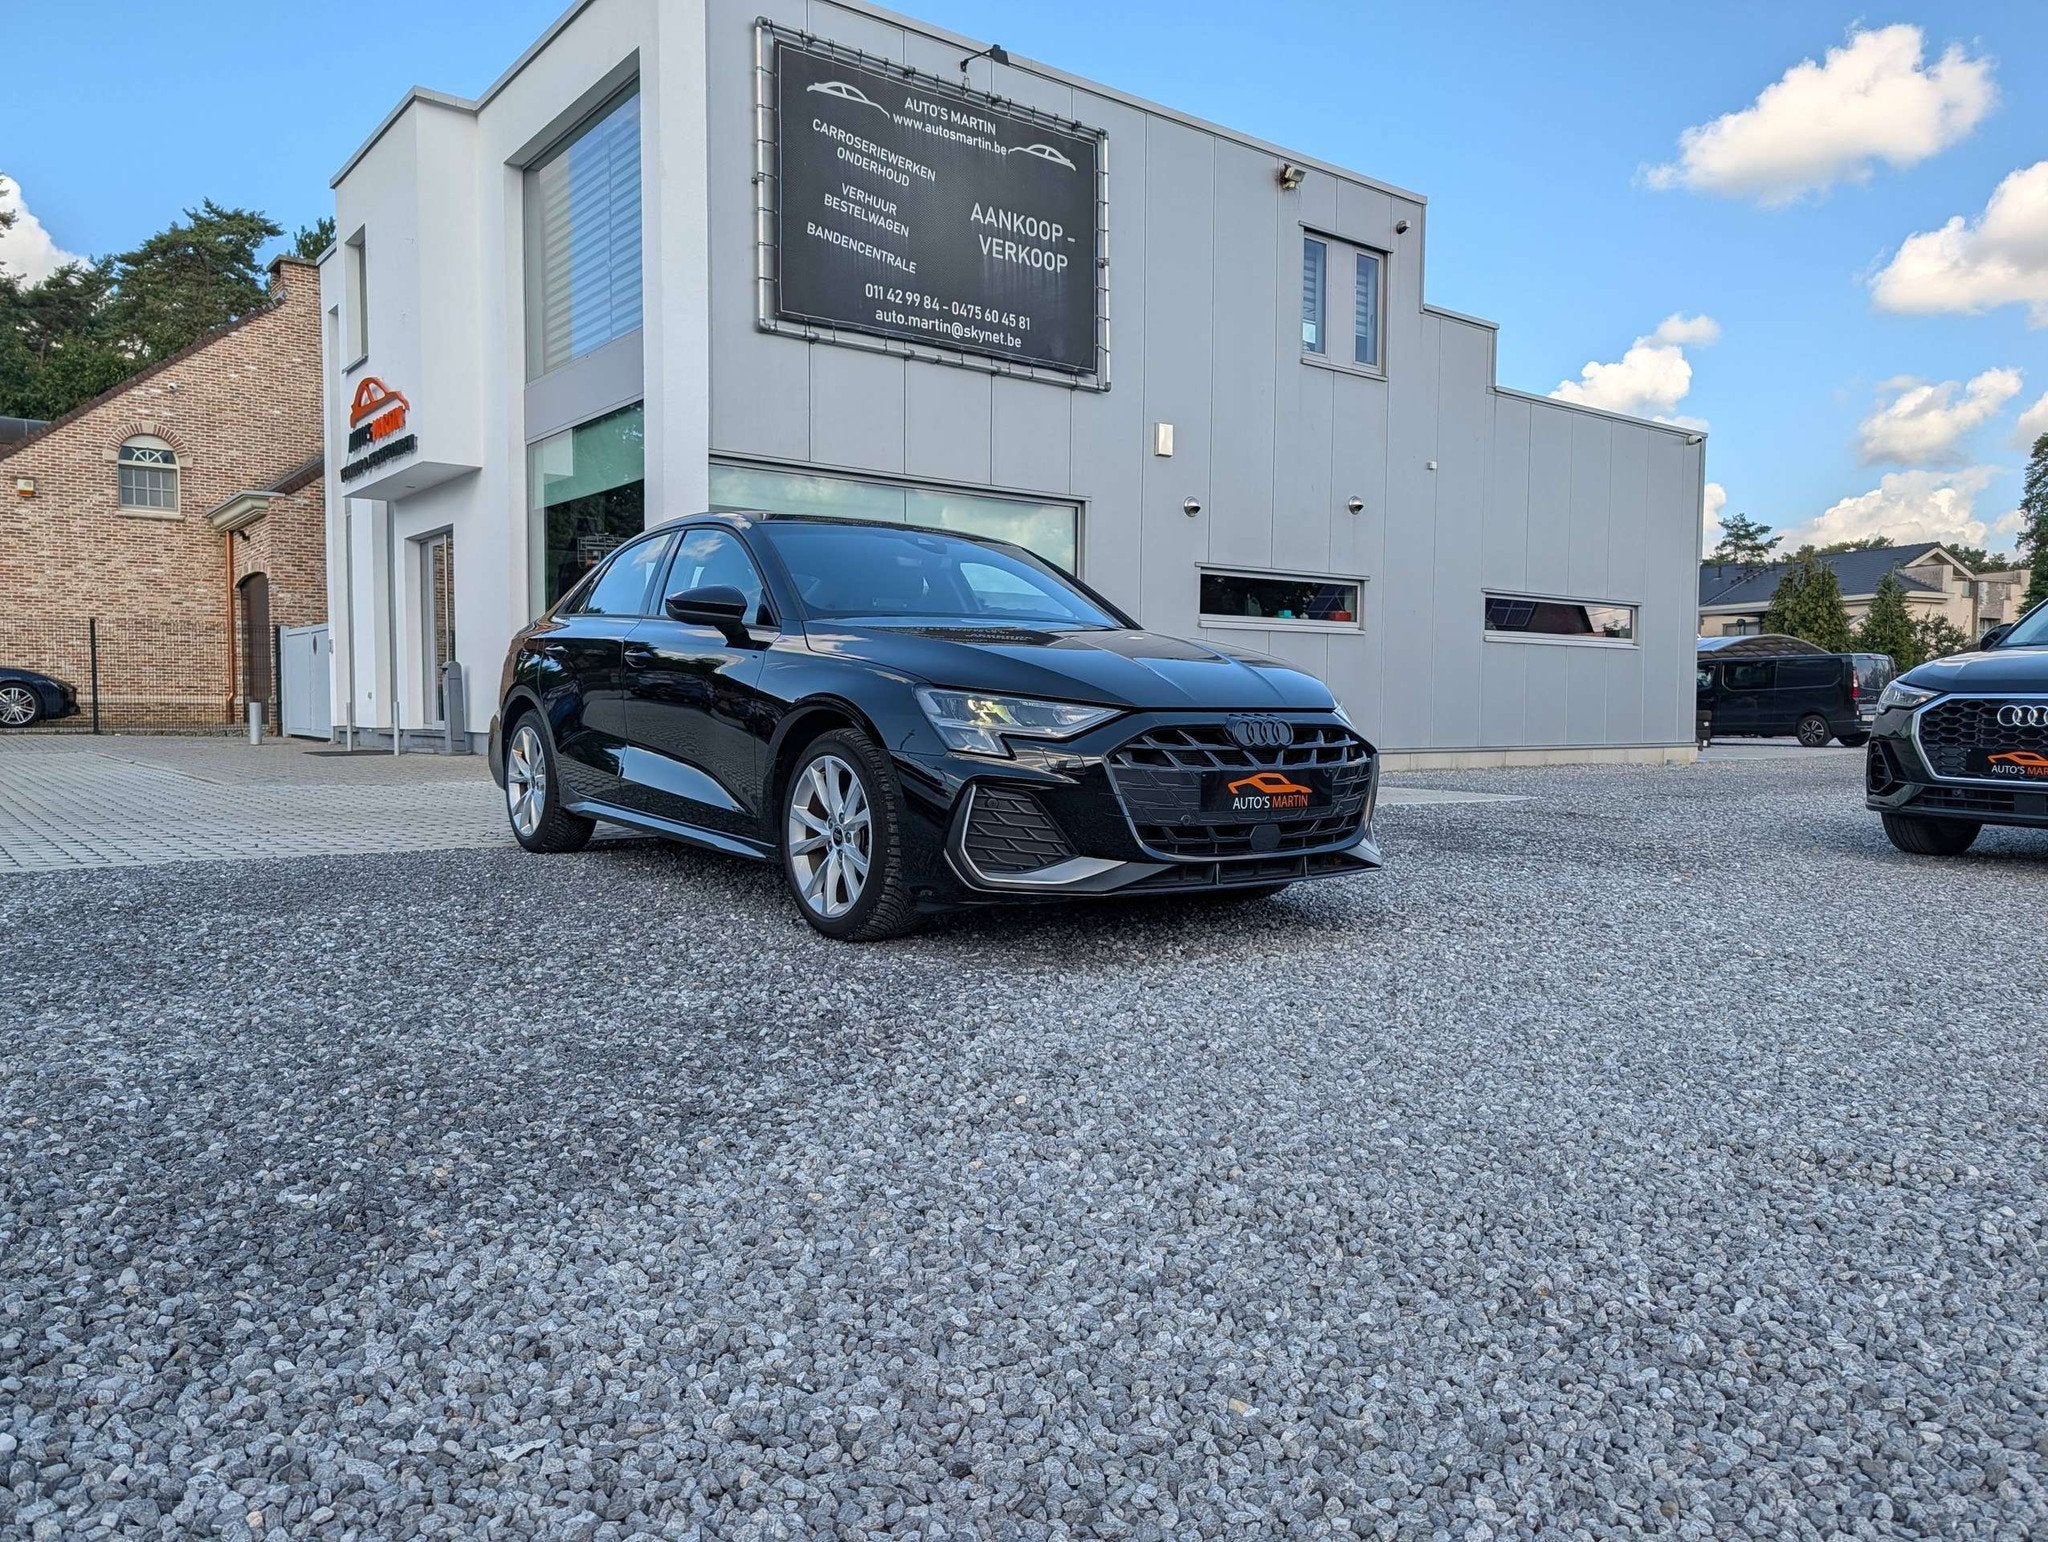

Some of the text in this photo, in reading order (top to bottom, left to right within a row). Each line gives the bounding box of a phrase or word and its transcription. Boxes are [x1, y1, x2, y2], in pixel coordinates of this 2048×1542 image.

[893, 113, 1007, 156] www.autosmartin.be
[904, 97, 996, 136] AUTO'S MARTIN
[812, 118, 936, 182] CARROSERIEWERKEN
[837, 147, 910, 187] ONDERHOUD
[824, 193, 909, 238] BESTELWAGEN
[842, 182, 897, 216] VERHUUR
[970, 202, 1063, 243] AANKOOP
[806, 221, 917, 274] BANDENCENTRALE
[979, 234, 1068, 273] VERKOOP
[865, 283, 884, 300] 011
[886, 288, 903, 304] 42
[906, 292, 920, 307] 99
[923, 295, 940, 311] 84
[951, 301, 982, 320] 0475
[984, 309, 999, 323] 60
[1001, 312, 1016, 327] 45
[1018, 316, 1031, 330] 81
[875, 309, 1022, 348] auto.martin@skynet.be
[1991, 764, 2026, 775] AUTO'S
[1232, 794, 1308, 810] AUTO'S MARTIN
